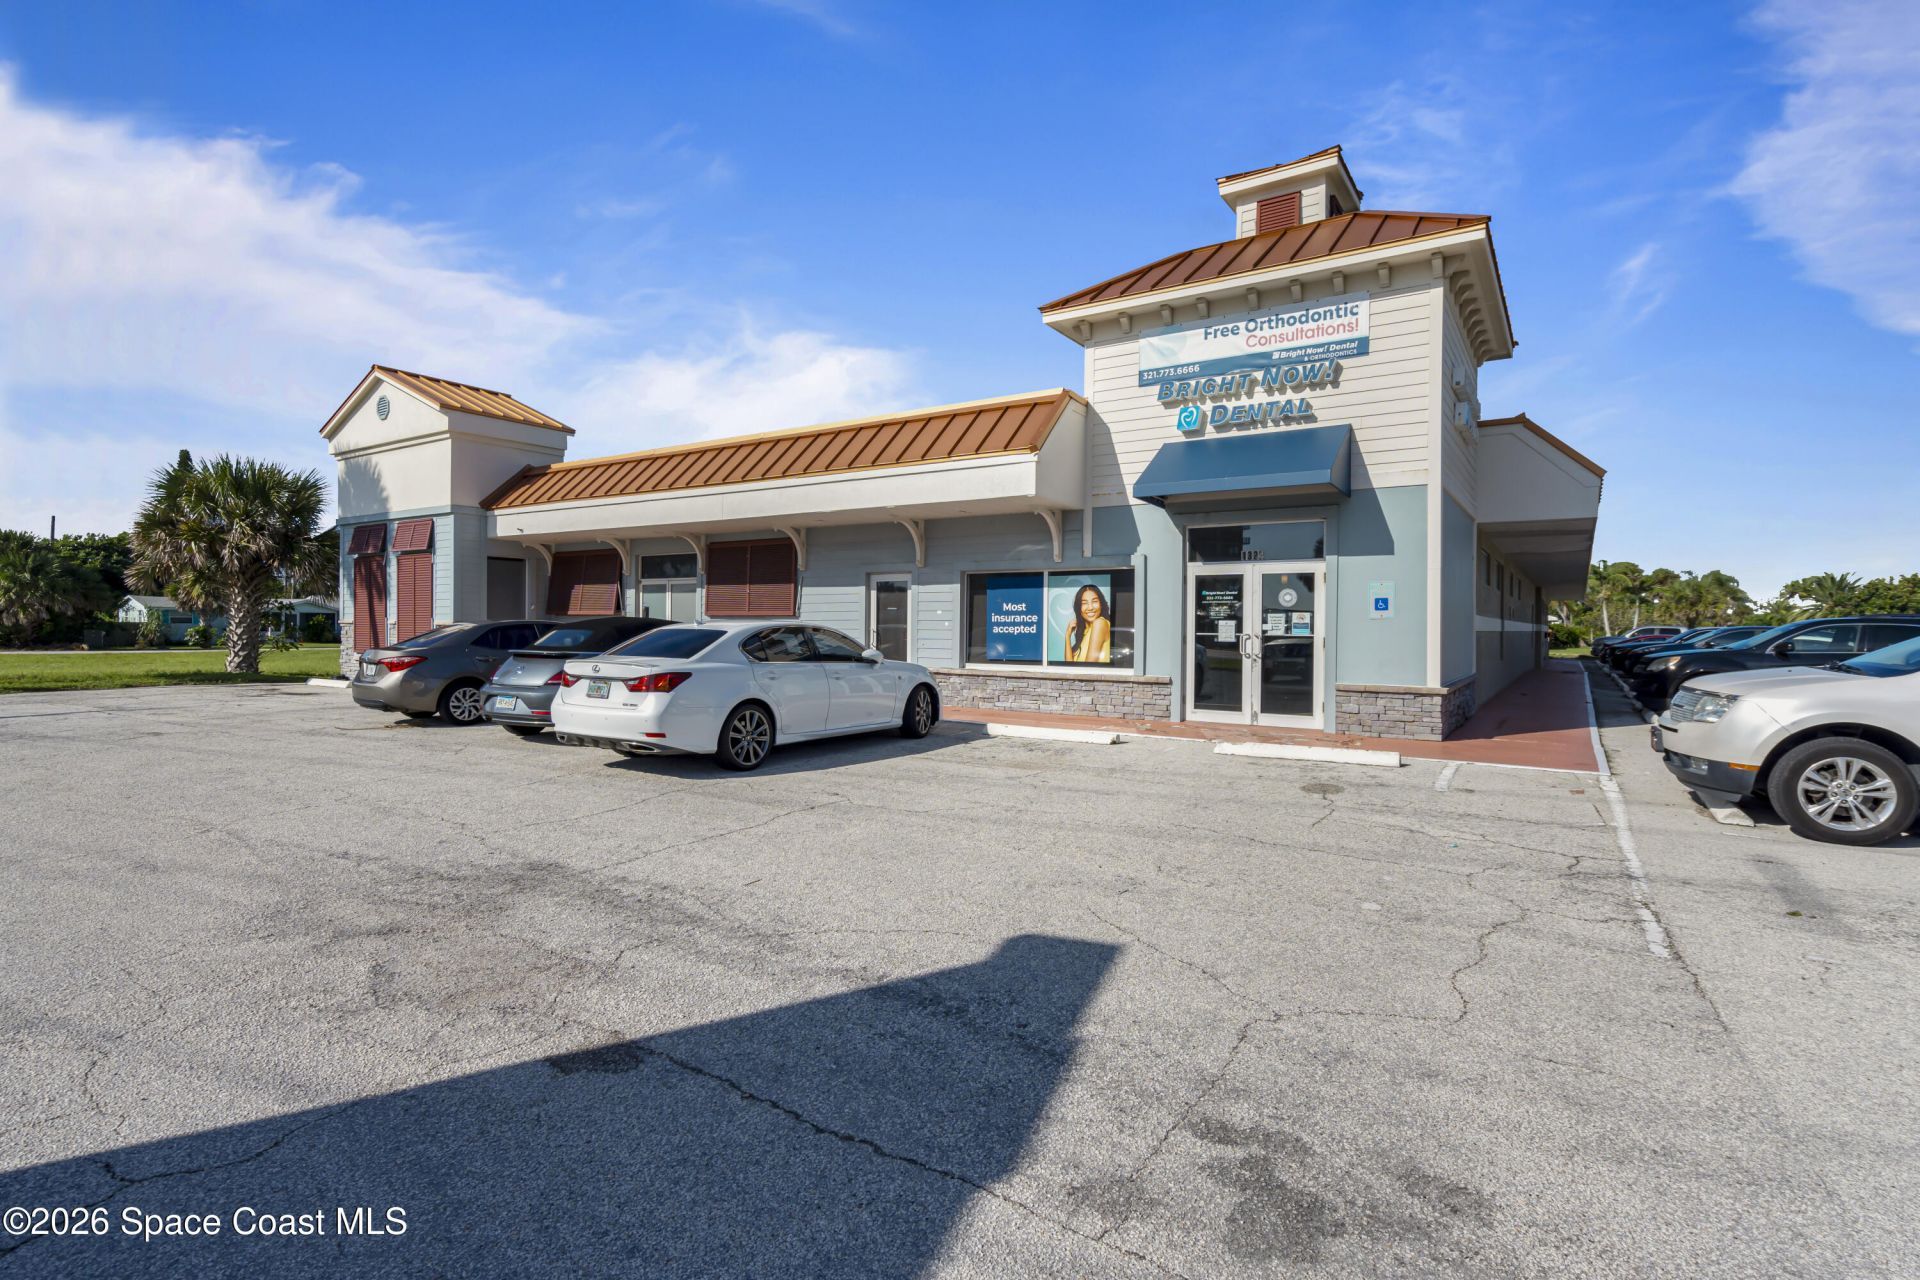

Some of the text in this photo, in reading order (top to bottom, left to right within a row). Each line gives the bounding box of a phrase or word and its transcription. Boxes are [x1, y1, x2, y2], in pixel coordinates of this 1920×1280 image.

[1203, 302, 1359, 341] Free Orthodontic
[1245, 318, 1360, 349] Consultations!
[1280, 341, 1359, 359] Bright Now! Dental
[1142, 364, 1200, 380] 321.773.6666
[1157, 358, 1339, 401] BRIGHT NOW!
[1209, 398, 1312, 427] DENTAL
[1002, 602, 1026, 612] Most
[991, 613, 1039, 623] insurance
[992, 624, 1037, 636] accepted
